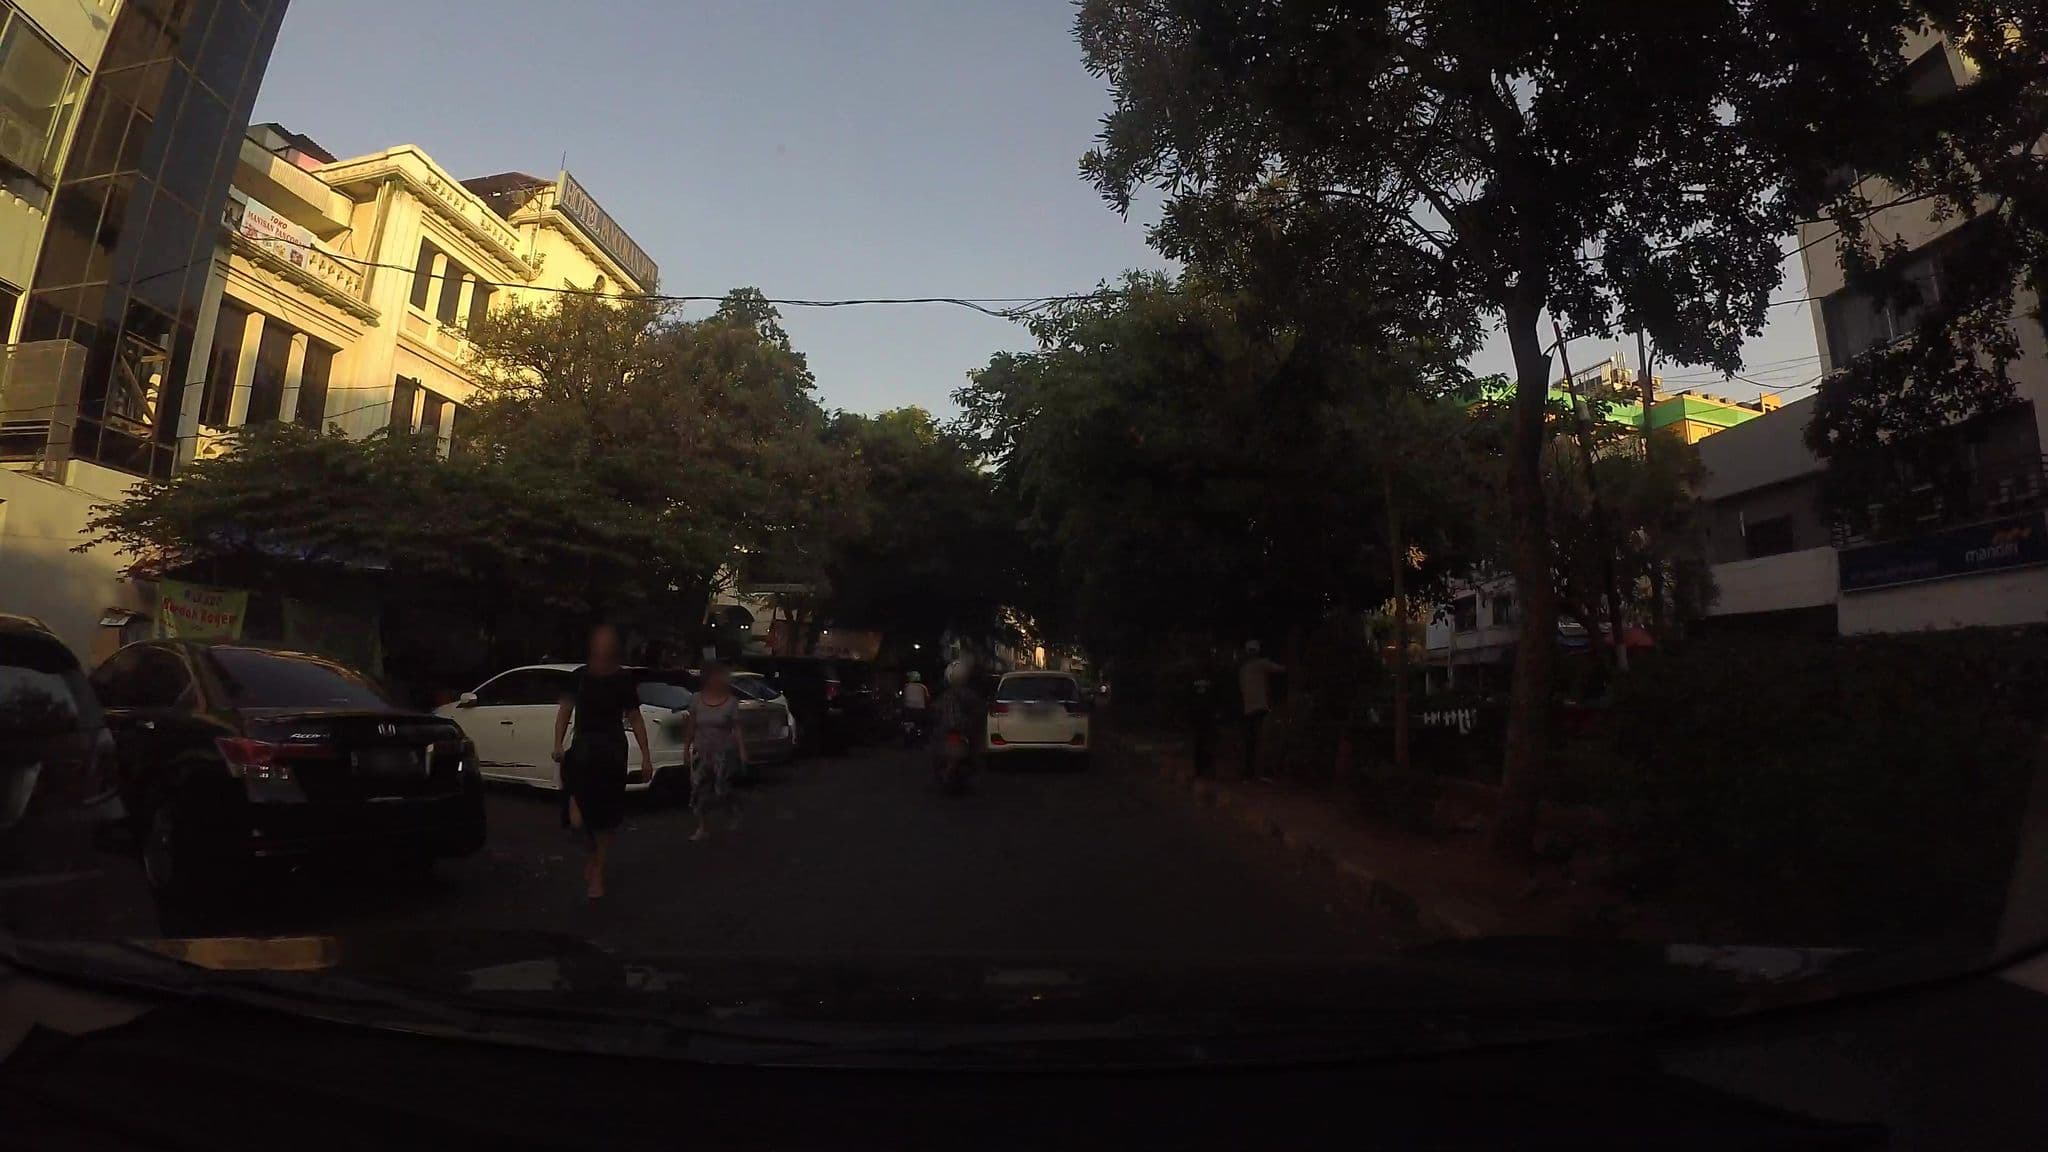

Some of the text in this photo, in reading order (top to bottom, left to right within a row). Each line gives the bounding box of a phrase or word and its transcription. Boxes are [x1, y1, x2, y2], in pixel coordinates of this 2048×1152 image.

[564, 178, 600, 236] HOTEL
[248, 210, 274, 233] MANISAN
[270, 215, 288, 229] TOKO
